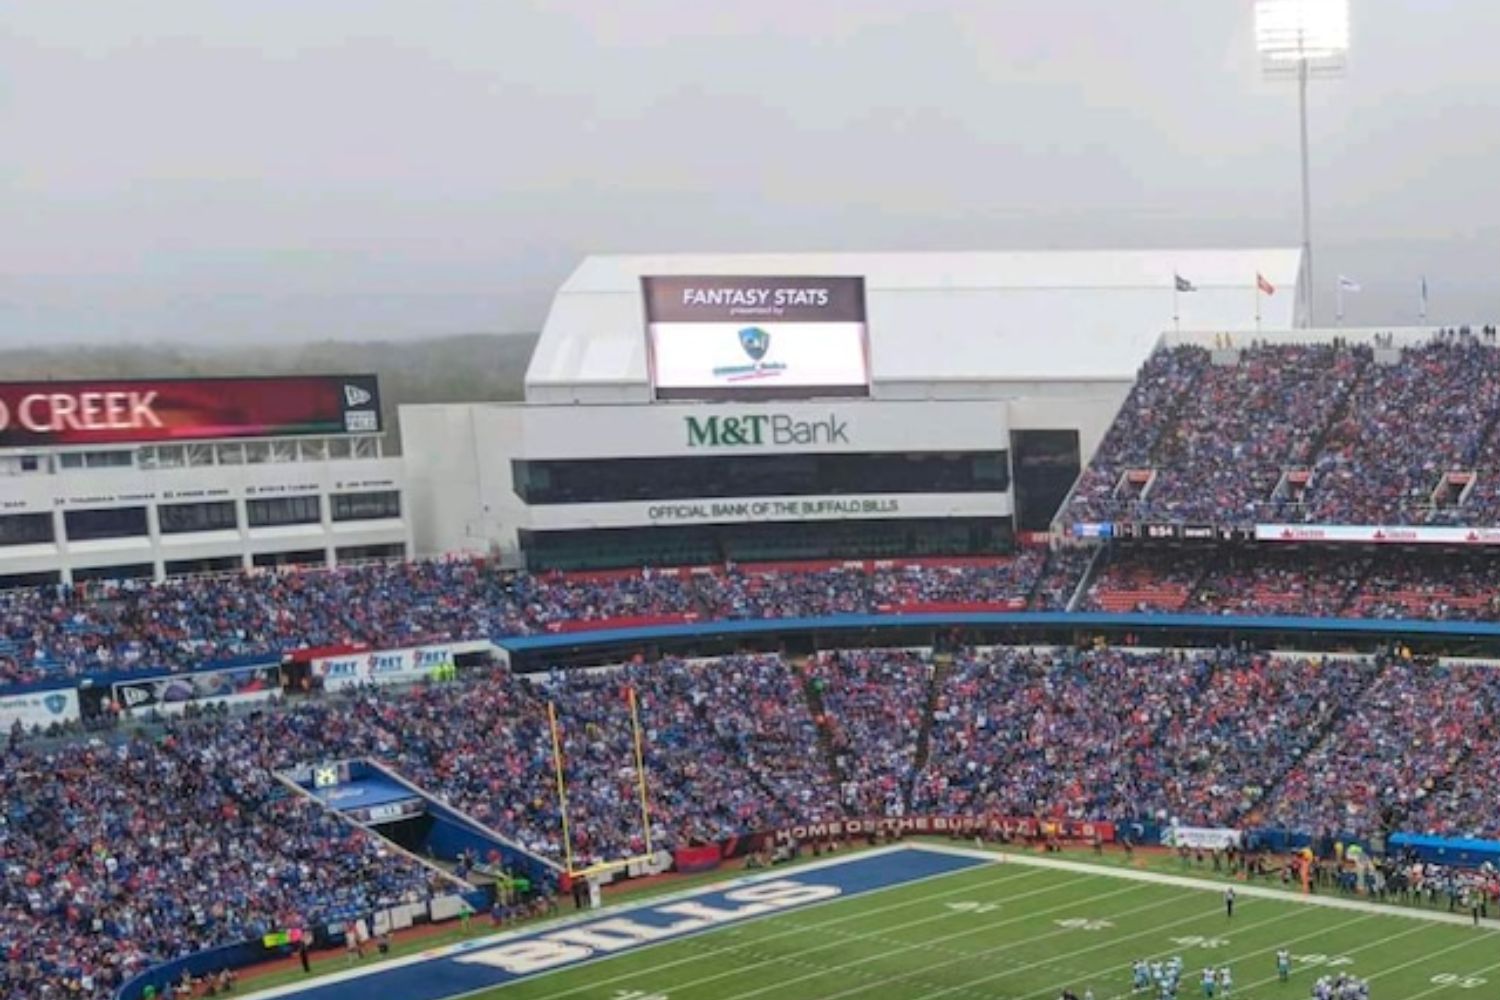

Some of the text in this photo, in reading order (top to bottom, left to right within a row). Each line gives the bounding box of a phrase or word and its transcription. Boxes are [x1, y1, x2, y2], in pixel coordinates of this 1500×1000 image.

[683, 288, 829, 305] FANTASY STATS
[18, 390, 162, 432] CREEK
[686, 414, 850, 446] M&T Bank
[649, 500, 899, 519] OFFICIAL BANK OF THE BUFFALO BILLS
[777, 822, 842, 841] HOME
[453, 881, 843, 974] BILLS
